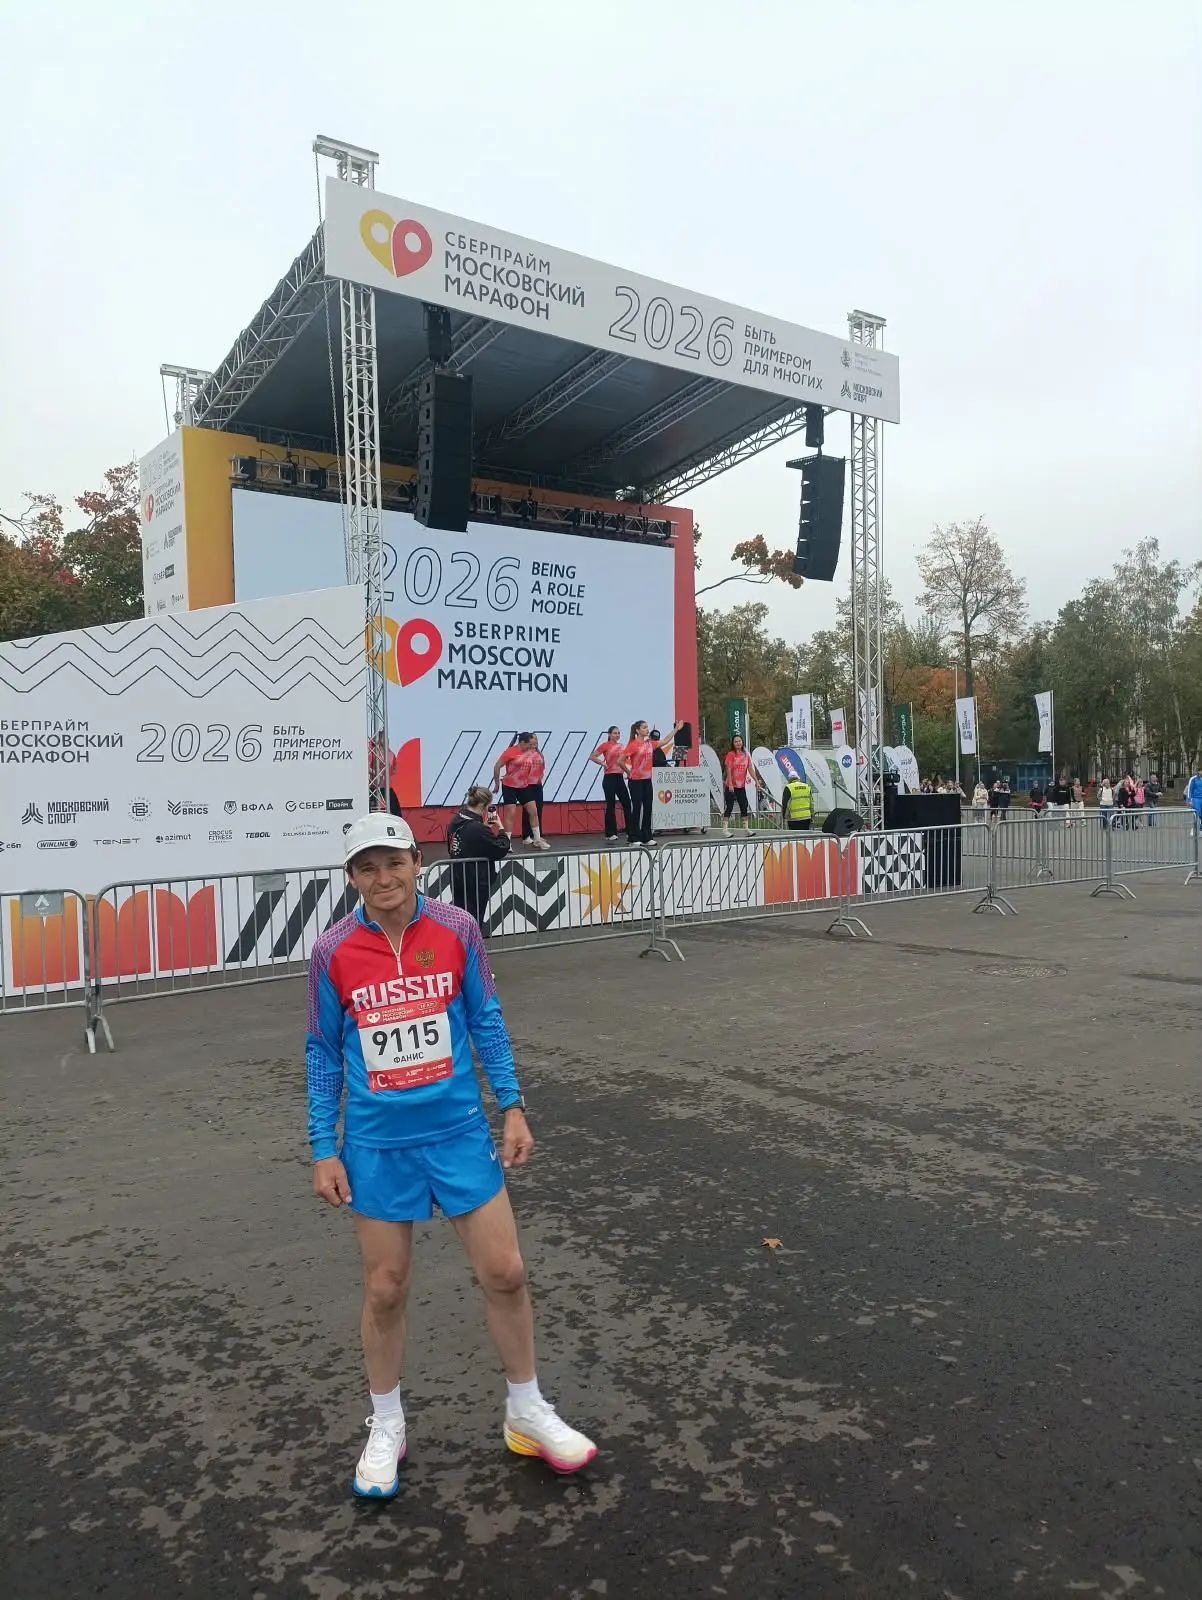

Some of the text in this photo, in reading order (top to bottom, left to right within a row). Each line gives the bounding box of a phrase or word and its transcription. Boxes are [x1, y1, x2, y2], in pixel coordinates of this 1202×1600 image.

[445, 231, 551, 275] СБЕРПРАЙМ
[445, 250, 585, 308] МОСКОВСКИЙ
[445, 274, 550, 320] МАРАФОН
[609, 286, 735, 366] 2026
[743, 324, 777, 345] БЫТЬ
[743, 341, 812, 372] ПРИМЕРОМ
[742, 358, 823, 390] ДЛЯ МНОГИХ
[366, 541, 521, 611] 2026
[532, 561, 577, 579] BEING
[531, 580, 586, 598] A ROLE
[531, 599, 584, 616] MODEL
[454, 621, 561, 643] SBERPRIME
[448, 643, 555, 668] MOSCOW
[437, 668, 568, 693] MARATHON
[0, 719, 89, 731] БЕРПРАЙМ
[273, 725, 305, 735] БЫТЬ
[0, 733, 123, 748] ОСКОВСКИЙ
[136, 722, 263, 763] 2026
[273, 738, 341, 748] ПРИМЕРОМ
[0, 750, 89, 763] АРАФОН
[273, 750, 353, 762] ДЛЯ МНОГИХ
[47, 798, 110, 812] МОСКОВСКИЙ
[182, 807, 209, 815] BRICS
[241, 803, 274, 812] ВФЛА
[299, 801, 324, 810] СБЕР
[47, 813, 77, 824] СПОРТ
[164, 833, 191, 841] azimut
[352, 972, 453, 1012] RUSSIA
[372, 1020, 440, 1056] 9115
[393, 1051, 425, 1064] ФАНИС
